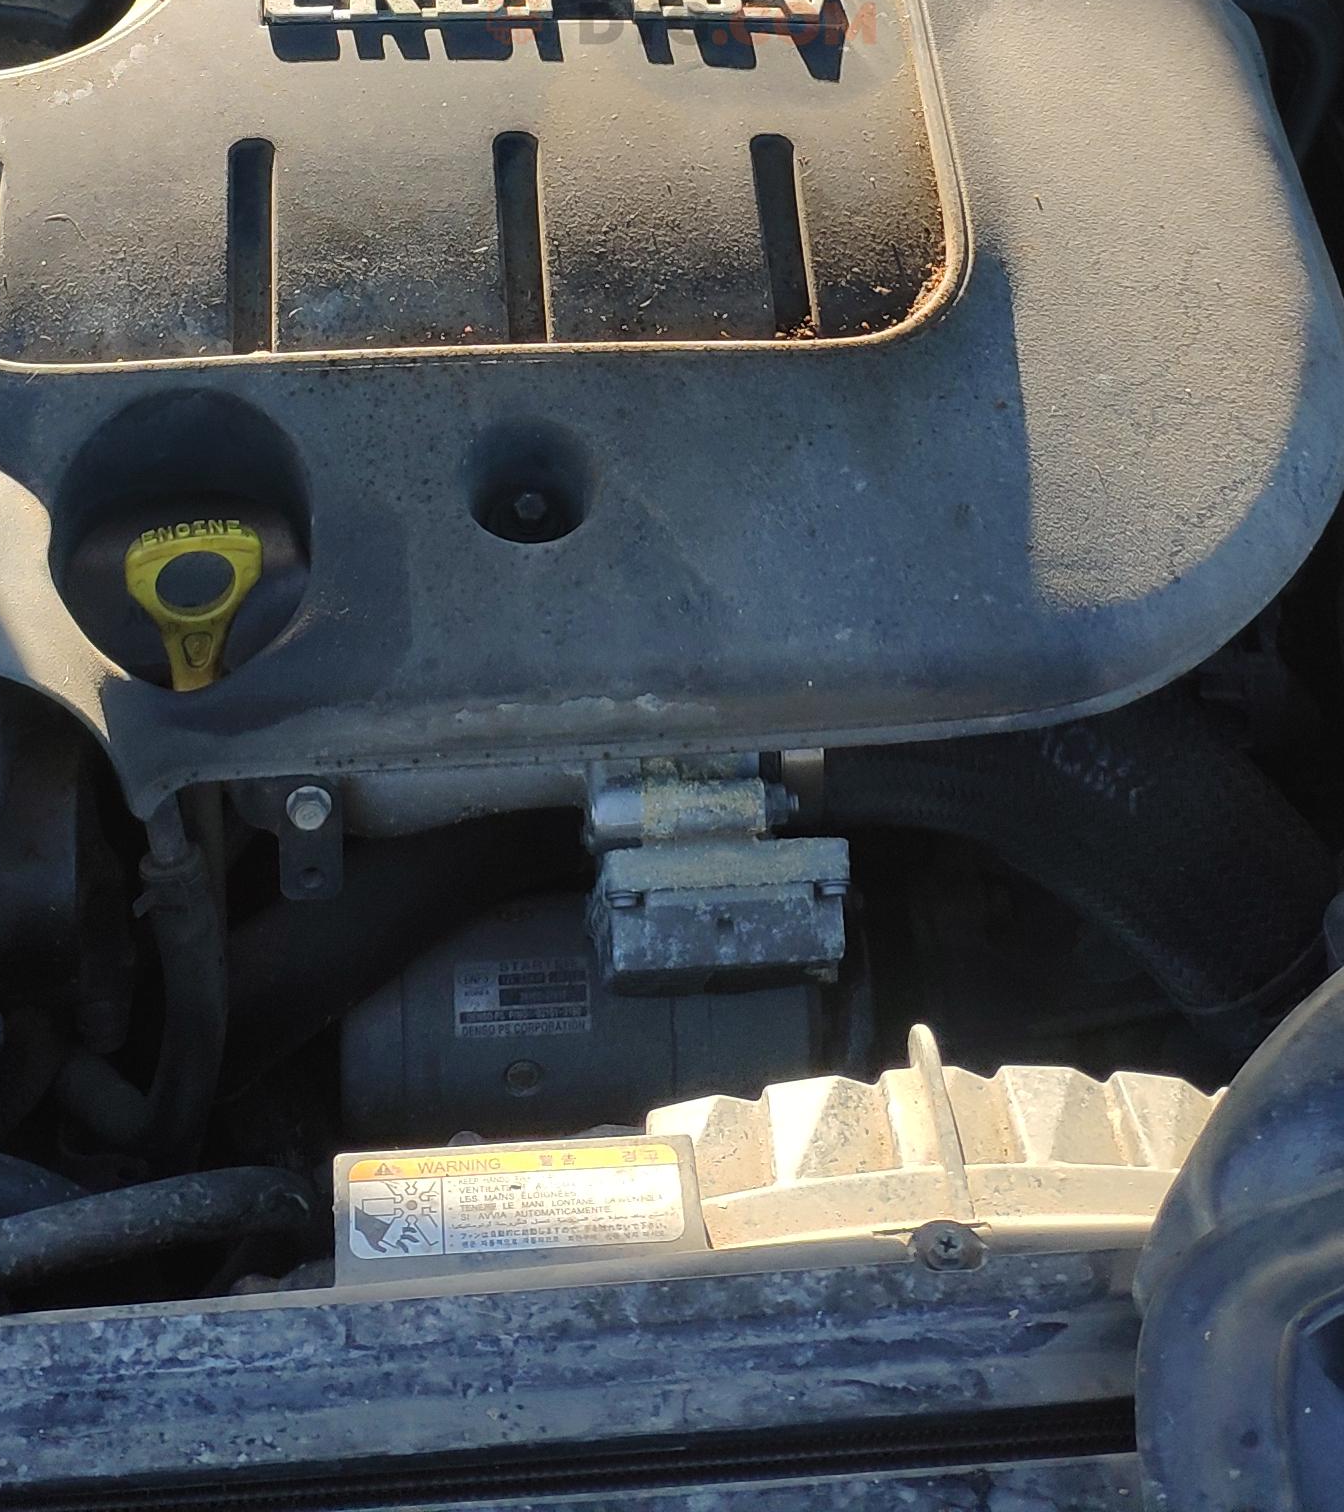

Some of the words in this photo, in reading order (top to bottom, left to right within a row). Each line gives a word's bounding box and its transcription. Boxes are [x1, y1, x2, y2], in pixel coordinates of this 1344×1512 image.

[139, 519, 243, 545] ENGINE
[462, 1024, 496, 1037] DENSO
[514, 1020, 586, 1034] CORPORATION
[417, 1158, 501, 1174] WARNING
[515, 1205, 612, 1218] AUTOMATICAMENTE
